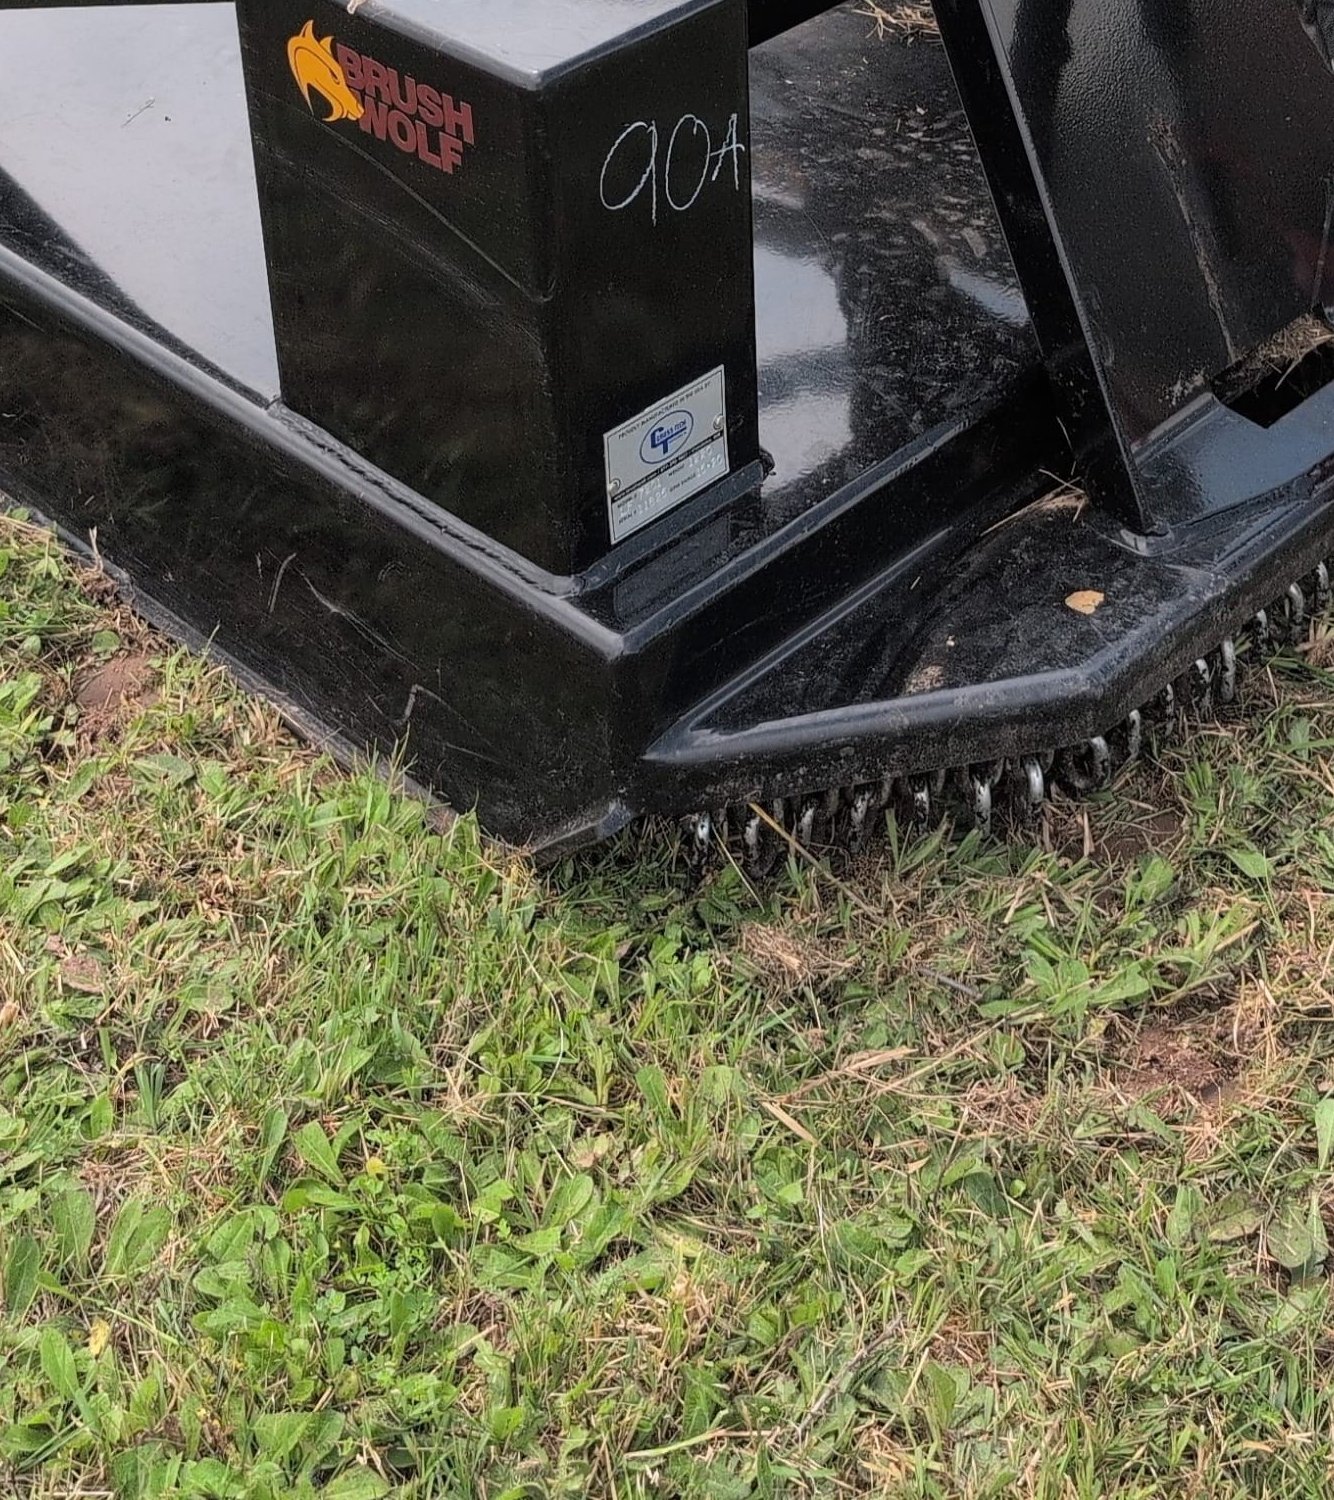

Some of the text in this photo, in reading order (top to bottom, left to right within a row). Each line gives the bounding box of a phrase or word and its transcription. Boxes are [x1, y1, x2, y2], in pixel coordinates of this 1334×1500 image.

[336, 42, 475, 146] BRUSH
[349, 89, 464, 176] WOLF
[599, 112, 746, 227] 90A
